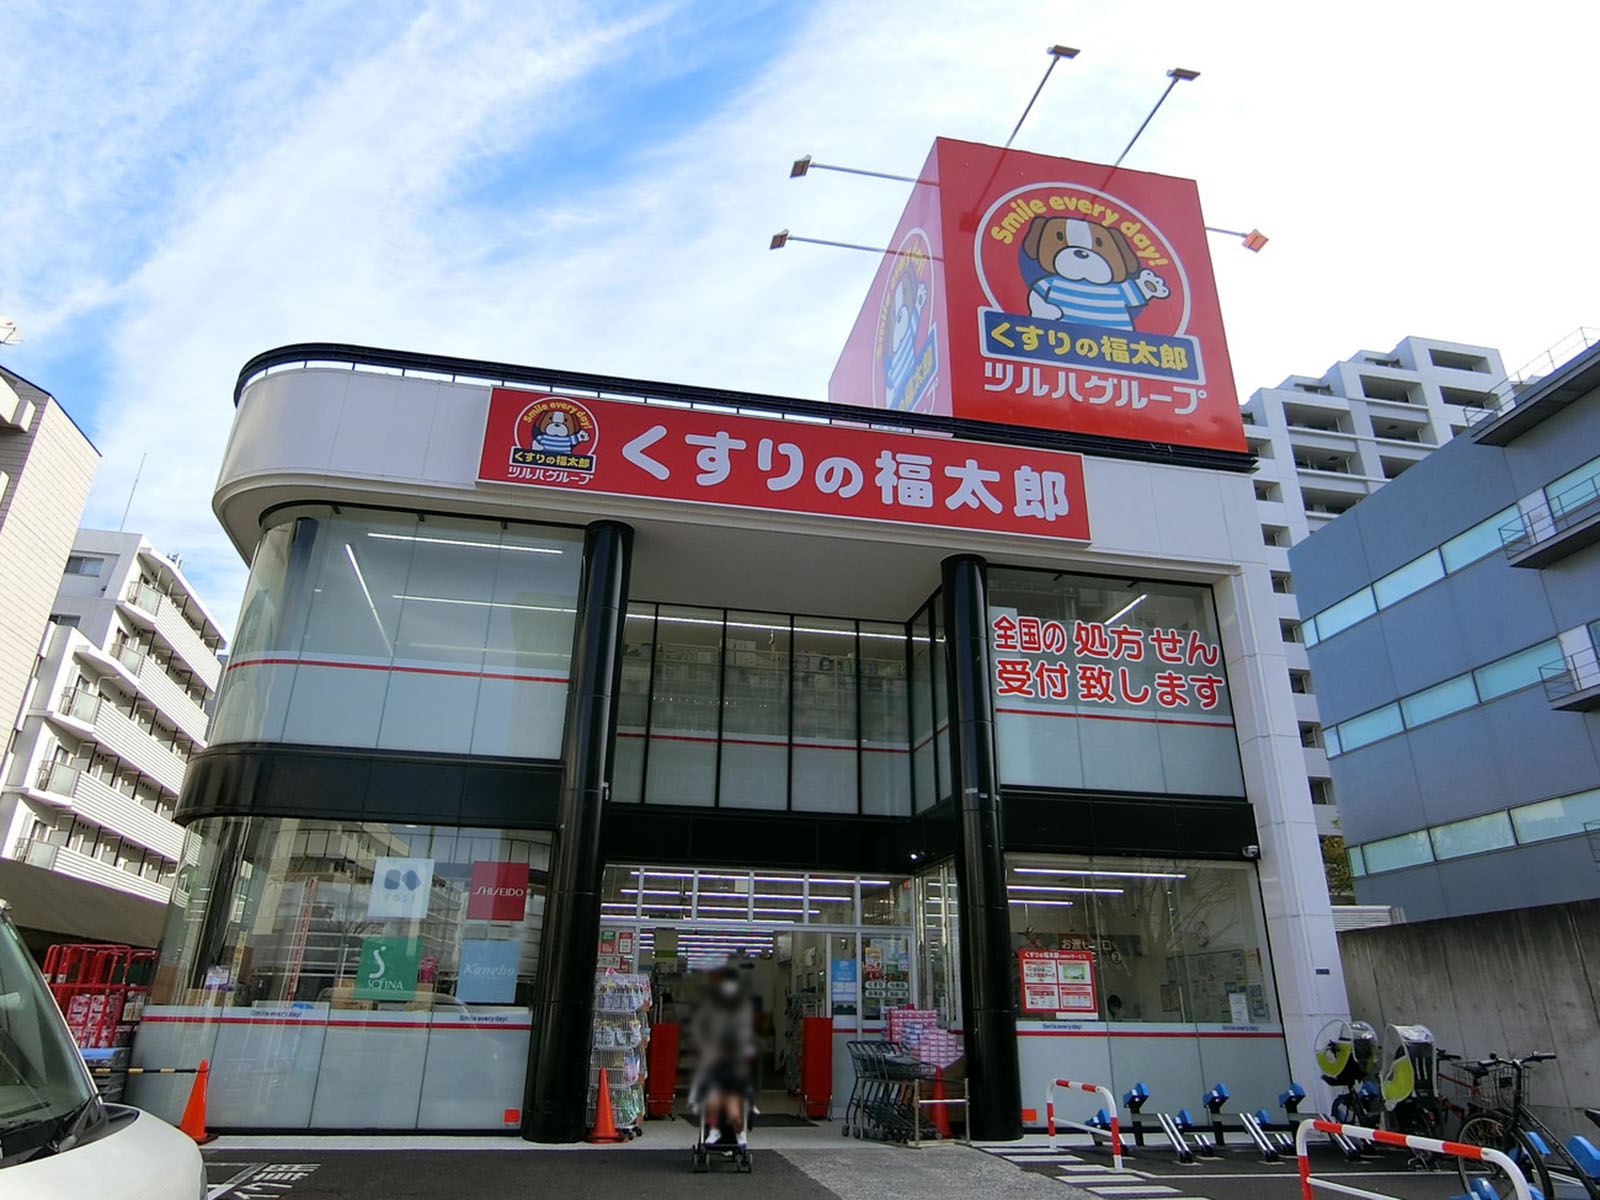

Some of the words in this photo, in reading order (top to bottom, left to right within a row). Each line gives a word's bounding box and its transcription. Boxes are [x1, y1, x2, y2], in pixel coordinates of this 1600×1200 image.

[991, 199, 1047, 245] Smile
[1049, 195, 1119, 225] every
[1120, 220, 1168, 267] day!
[990, 321, 1189, 371] くすりの福太郎
[984, 361, 1207, 415] ツルハグループ
[523, 404, 548, 423] Smile
[550, 402, 577, 414] every
[577, 411, 592, 430] day!
[514, 452, 590, 468] くすりの福太郎
[507, 466, 594, 485] ツルハグループ
[622, 424, 1069, 522] くすりの福太郎
[474, 885, 524, 897] SHISEIDO
[463, 963, 516, 976] Kanebo
[367, 978, 404, 991] SOFINA
